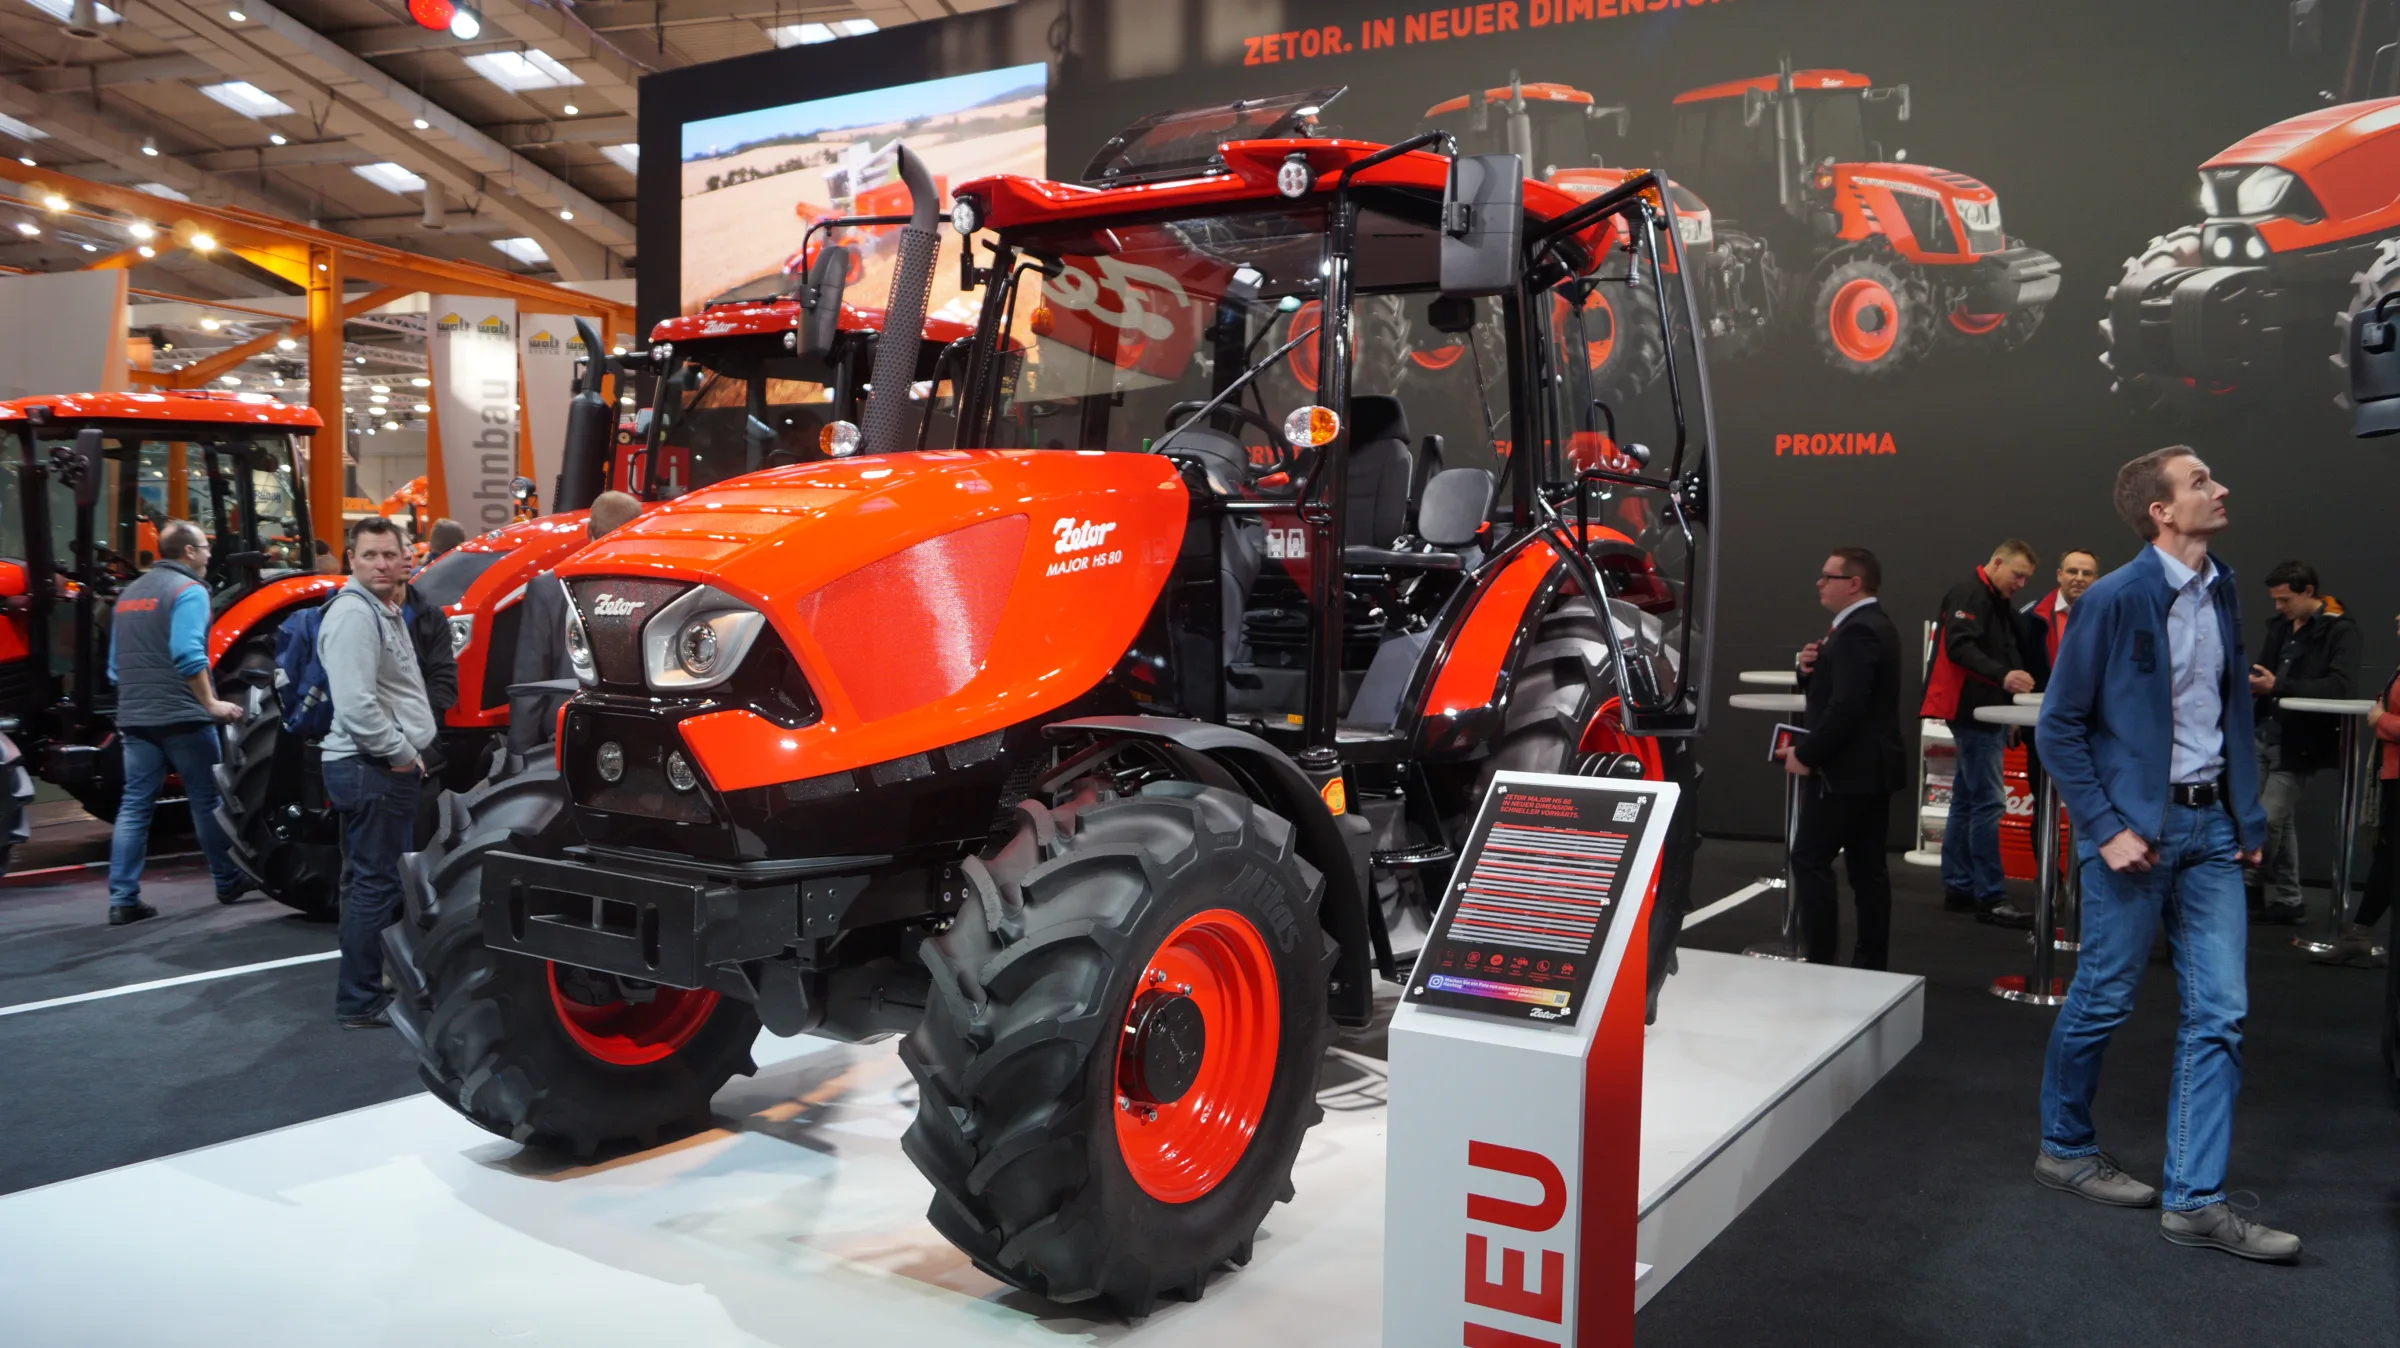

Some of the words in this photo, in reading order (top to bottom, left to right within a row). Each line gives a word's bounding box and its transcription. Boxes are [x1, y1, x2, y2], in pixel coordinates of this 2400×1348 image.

[1243, 25, 1353, 66] ZETOR.
[1361, 17, 1395, 50] IN
[1404, 1, 1520, 44] NEUER
[1775, 431, 1897, 456] PROXIMA
[1053, 516, 1118, 554] Zetor
[1046, 556, 1090, 577] MAJOR
[1092, 552, 1108, 567] HS
[1107, 549, 1123, 566] 80
[594, 593, 646, 616] Zetor
[1504, 793, 1527, 801] ZETOR
[1528, 795, 1550, 803] MAJOR
[1511, 800, 1534, 808] NEUER
[1535, 802, 1574, 811] DIMENSION
[1500, 806, 1540, 815] SCHNELLER
[1529, 1007, 1562, 1020] Zetor
